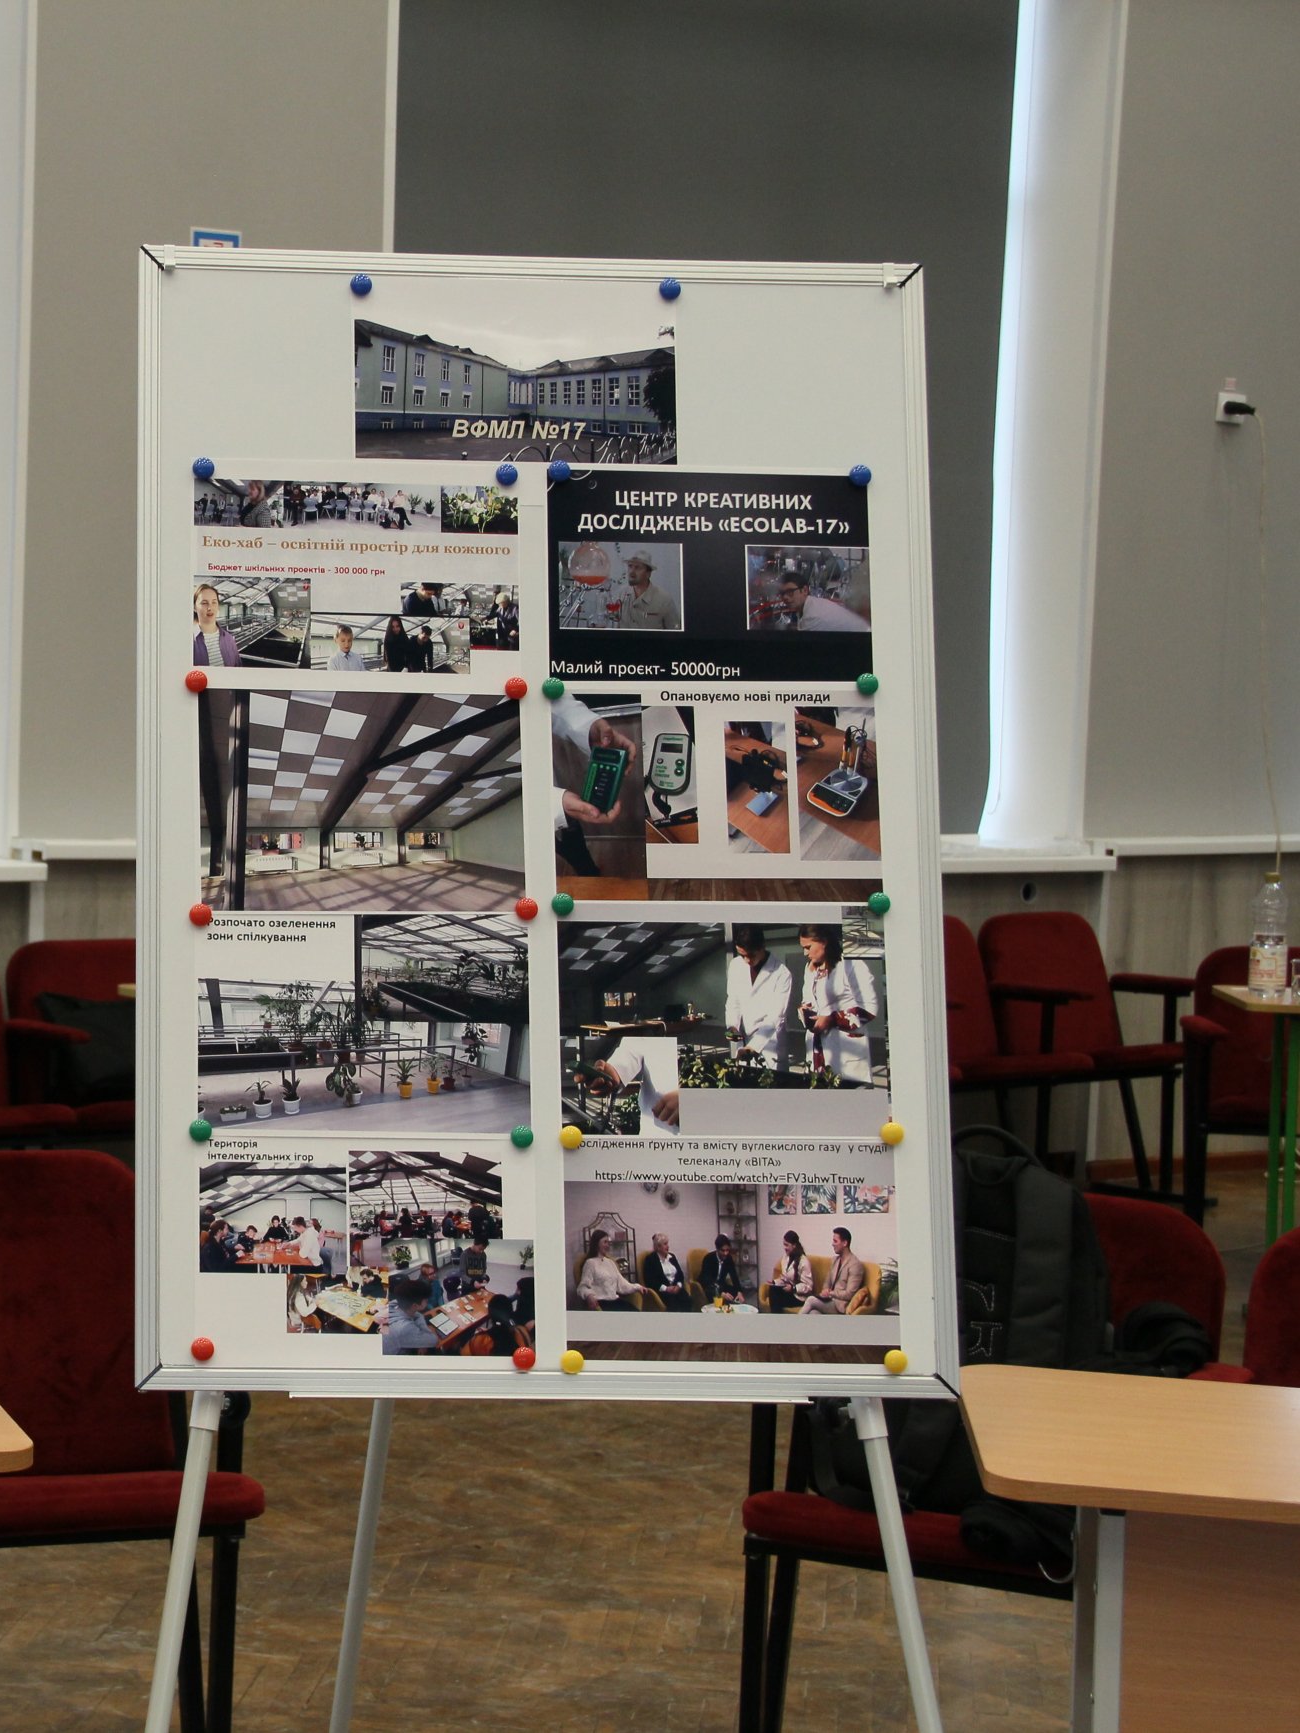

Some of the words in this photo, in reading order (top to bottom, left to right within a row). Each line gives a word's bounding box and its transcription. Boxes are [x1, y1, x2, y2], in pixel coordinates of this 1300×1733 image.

[452, 418, 525, 439] ВФМЛ
[531, 419, 587, 440] №17
[615, 490, 678, 510] ЦЕНТР
[684, 492, 813, 510] КРЕАТИВНИХ
[577, 513, 713, 534] ДОСЛІДЖЕНЬ
[718, 515, 850, 534] «ECOLAB-17»
[202, 535, 263, 549] Еко-хаб
[280, 538, 345, 551] освітній
[350, 541, 408, 555] простір
[412, 544, 439, 554] для
[444, 544, 511, 556] кожного
[208, 563, 242, 572] Бюджет
[245, 564, 285, 572] шкільних
[352, 567, 368, 575] 000
[370, 568, 386, 576] грн
[551, 660, 603, 674] Малий
[670, 661, 741, 679] 50000грн
[660, 690, 740, 702] Опановуємо
[744, 691, 772, 702] нові
[775, 692, 831, 704] прилади
[268, 919, 336, 929] озеленення
[207, 932, 233, 941] зони
[236, 932, 307, 943] спілкування
[208, 1138, 258, 1149] Територія
[577, 1138, 645, 1150] ослідження
[648, 1140, 684, 1151] ґрунту
[688, 1141, 699, 1150] та
[703, 1140, 738, 1152] вмісту
[741, 1142, 815, 1152] вуглекислого
[818, 1143, 841, 1153] газу
[848, 1145, 854, 1154] у
[207, 1151, 291, 1161] інтелектуальних
[294, 1152, 314, 1163] ігор
[678, 1156, 741, 1168] телеканалу
